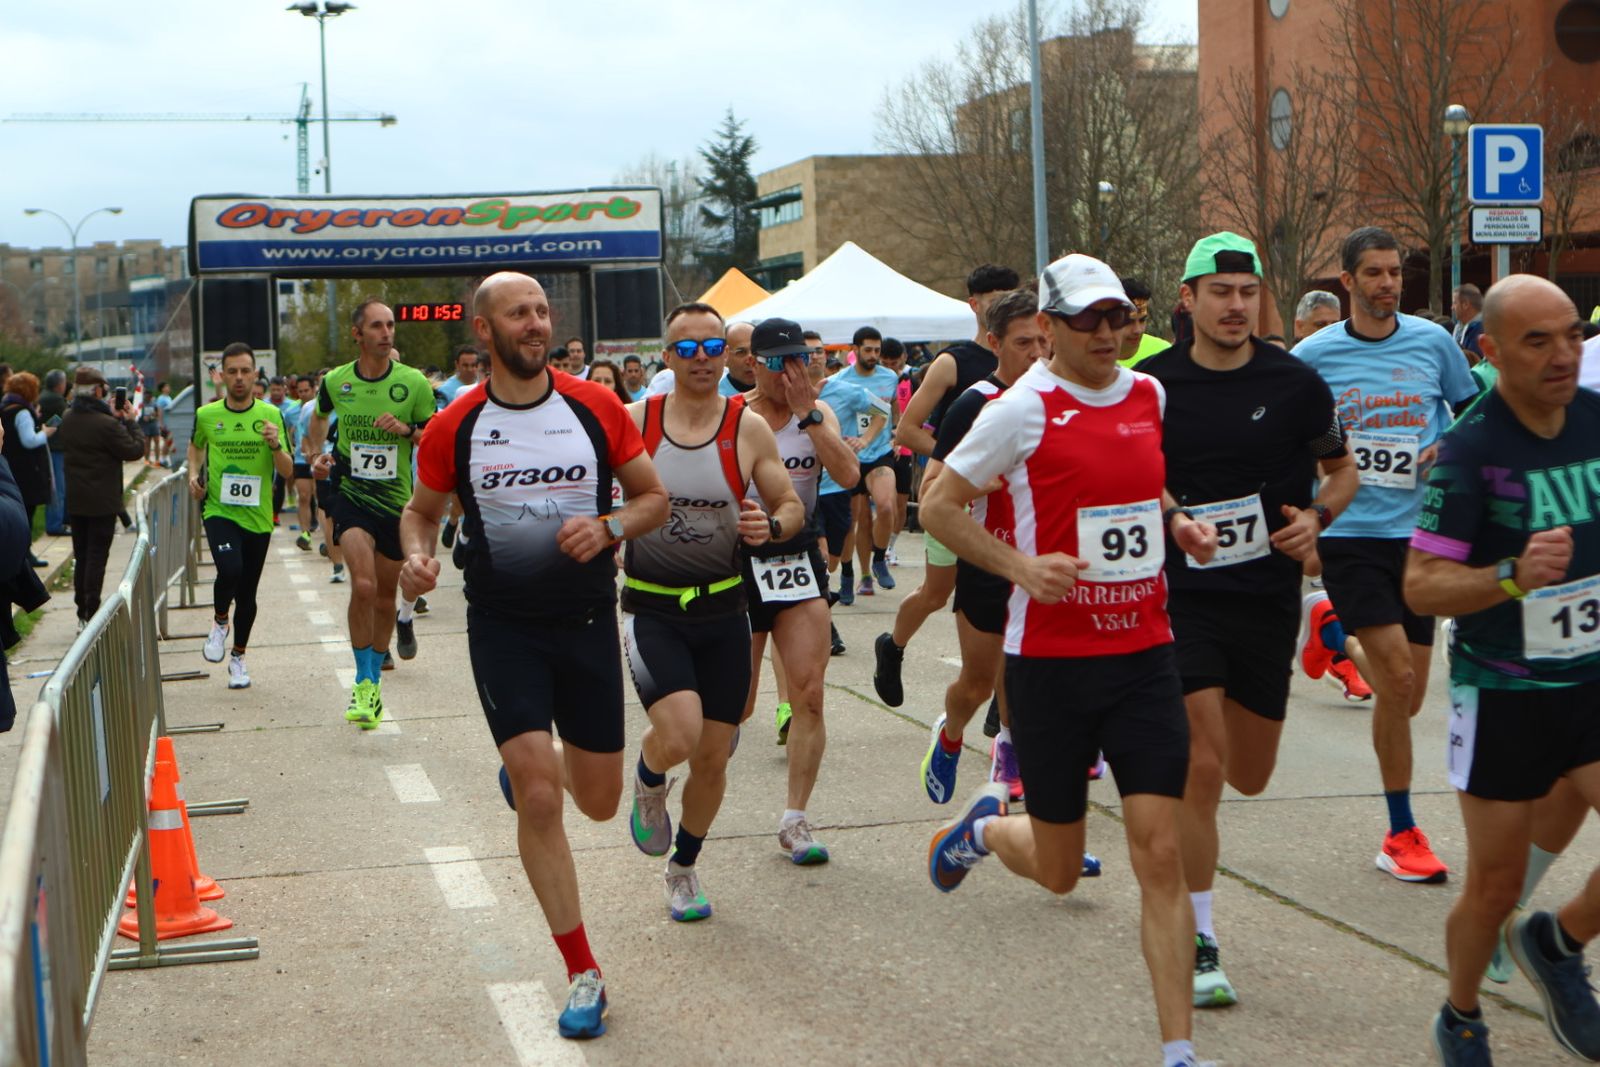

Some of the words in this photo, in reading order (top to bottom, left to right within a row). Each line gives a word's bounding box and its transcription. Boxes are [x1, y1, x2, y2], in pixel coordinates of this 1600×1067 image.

[1485, 134, 1528, 194] P
[216, 196, 642, 234] OrycronSport
[262, 239, 602, 261] www.orycronsport.com
[1365, 391, 1423, 410] contra
[1365, 413, 1382, 428] el
[1387, 410, 1429, 428] ictus
[483, 439, 510, 447] VIATOR
[361, 453, 387, 470] 79
[1354, 447, 1413, 475] 392
[481, 464, 586, 490] 37300
[229, 483, 252, 498] 80
[1101, 524, 1149, 561] 93
[760, 566, 811, 590] 126
